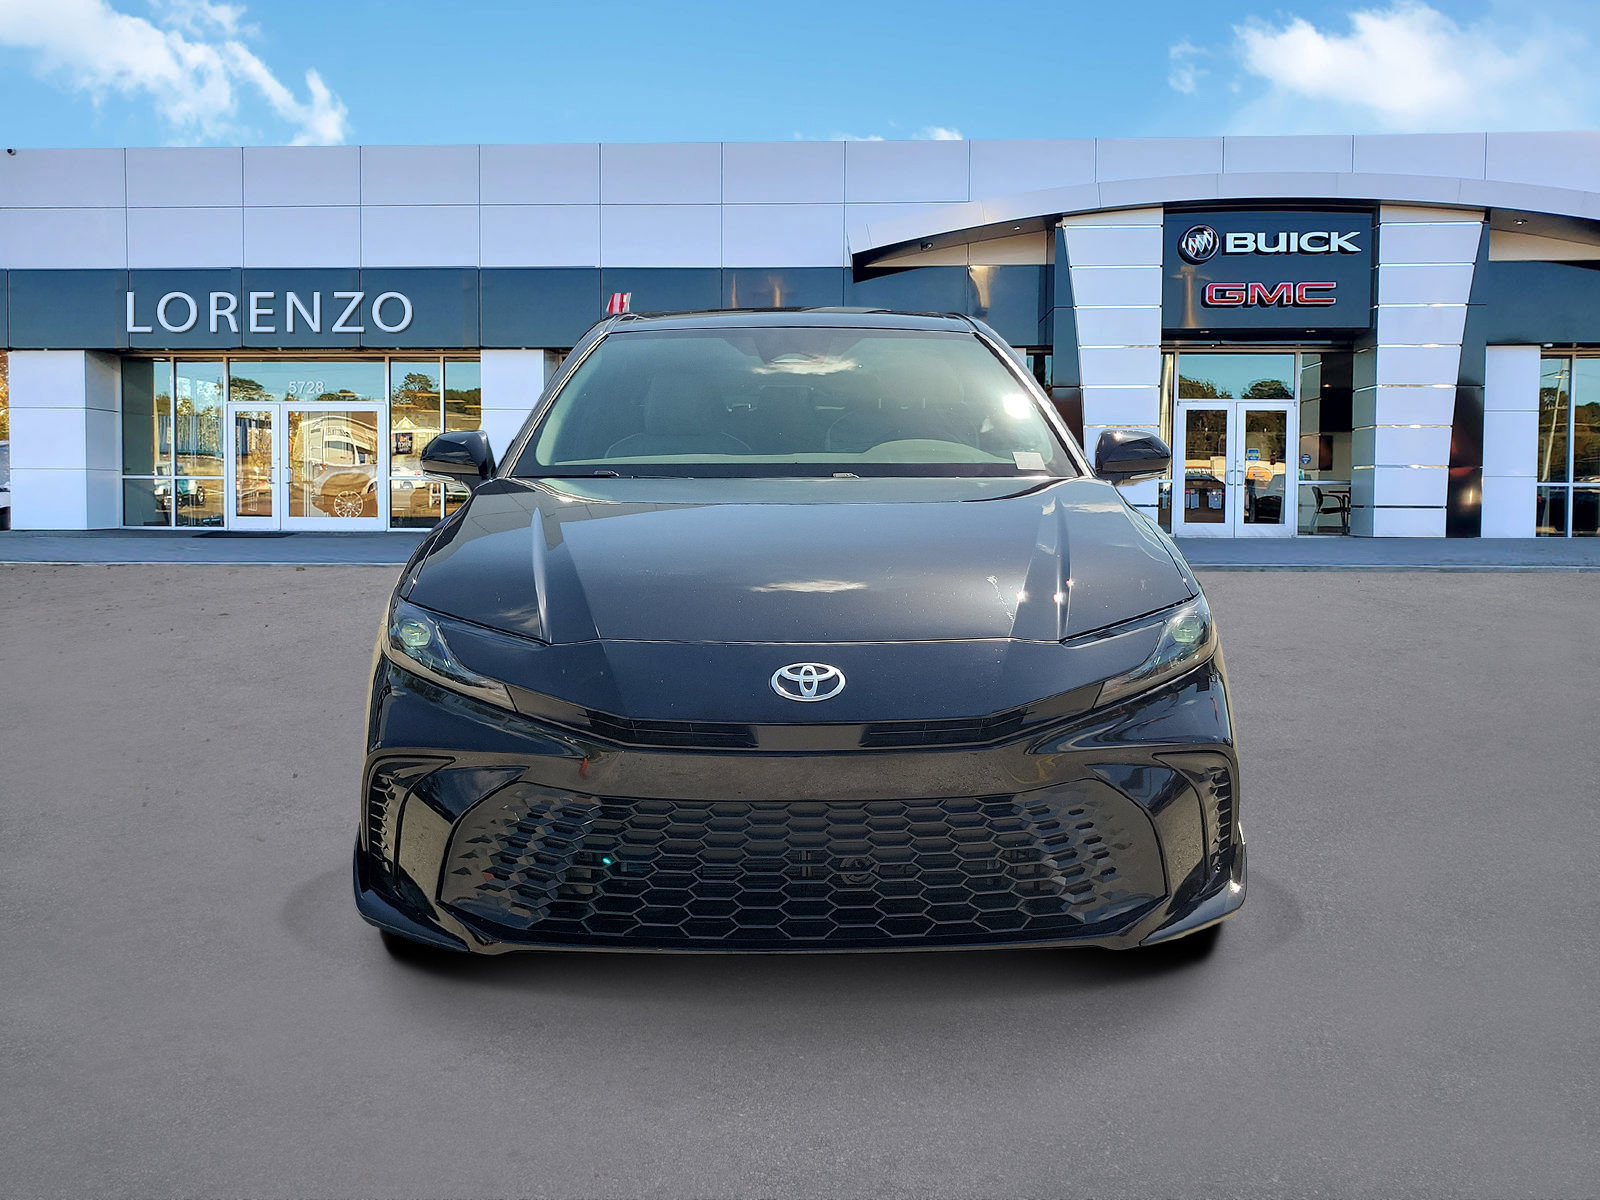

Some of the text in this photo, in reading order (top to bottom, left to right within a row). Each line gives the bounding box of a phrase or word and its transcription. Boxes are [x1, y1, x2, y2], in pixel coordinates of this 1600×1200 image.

[1225, 231, 1362, 254] BUICK
[1205, 281, 1337, 305] GMC
[126, 291, 414, 334] LORENZO
[288, 380, 325, 395] 5728
